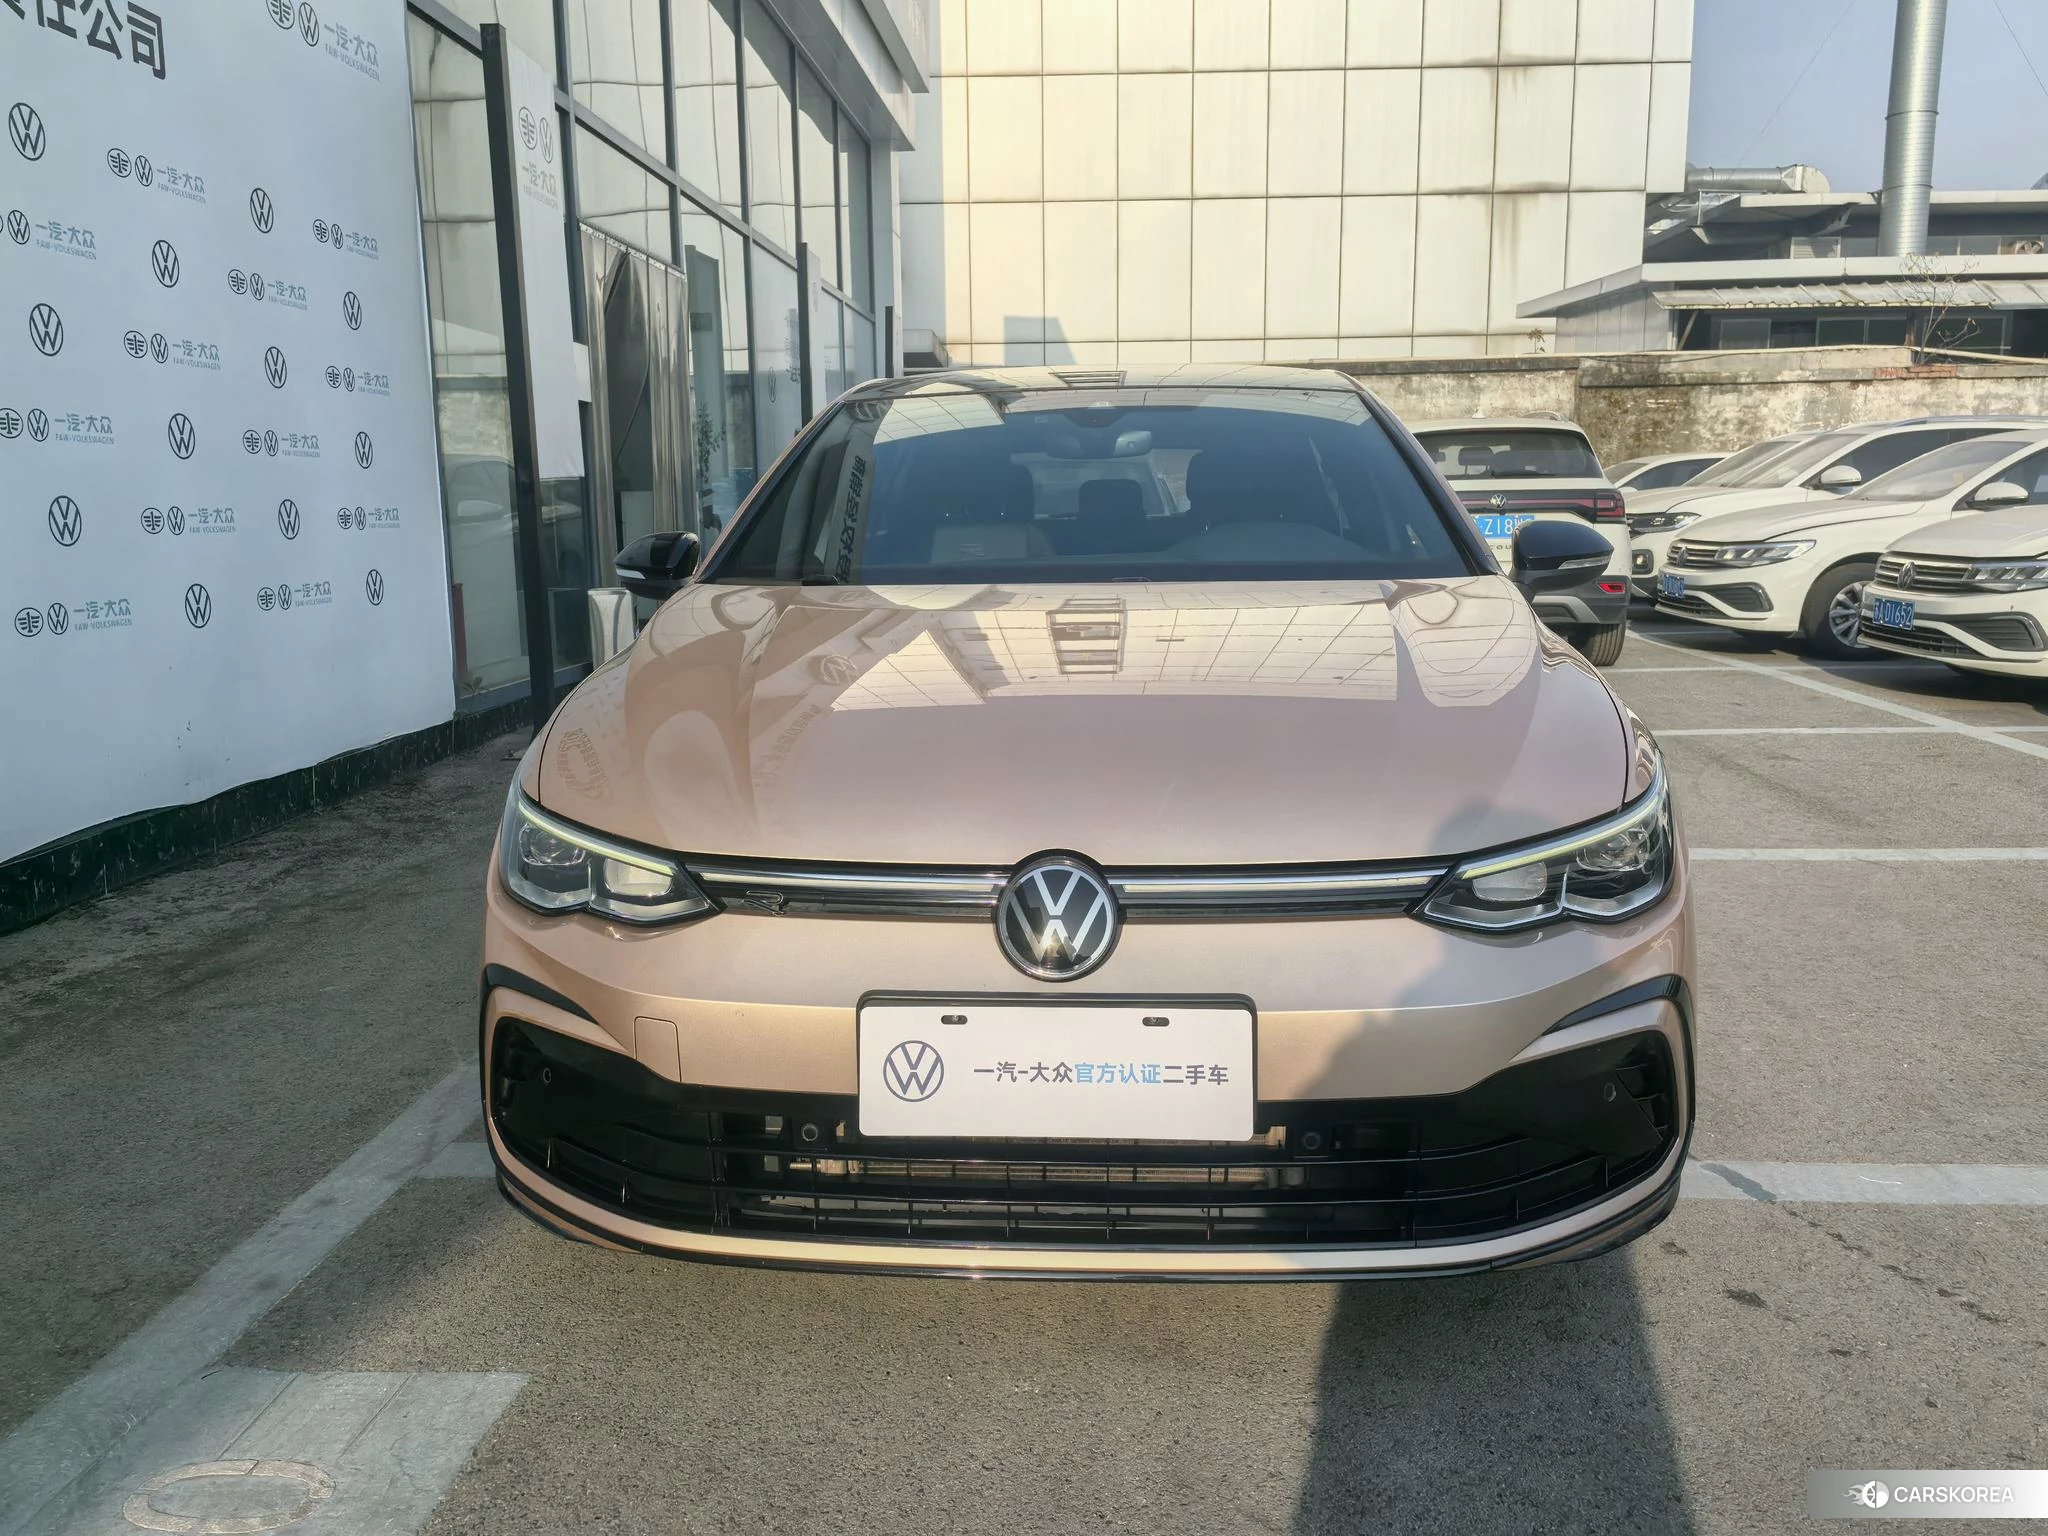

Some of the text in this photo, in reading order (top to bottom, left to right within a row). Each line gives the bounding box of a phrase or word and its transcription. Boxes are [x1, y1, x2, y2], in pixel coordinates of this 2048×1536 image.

[0, 0, 166, 80] 公司
[973, 1061, 1229, 1086] 一汽-大众官方认证二手车
